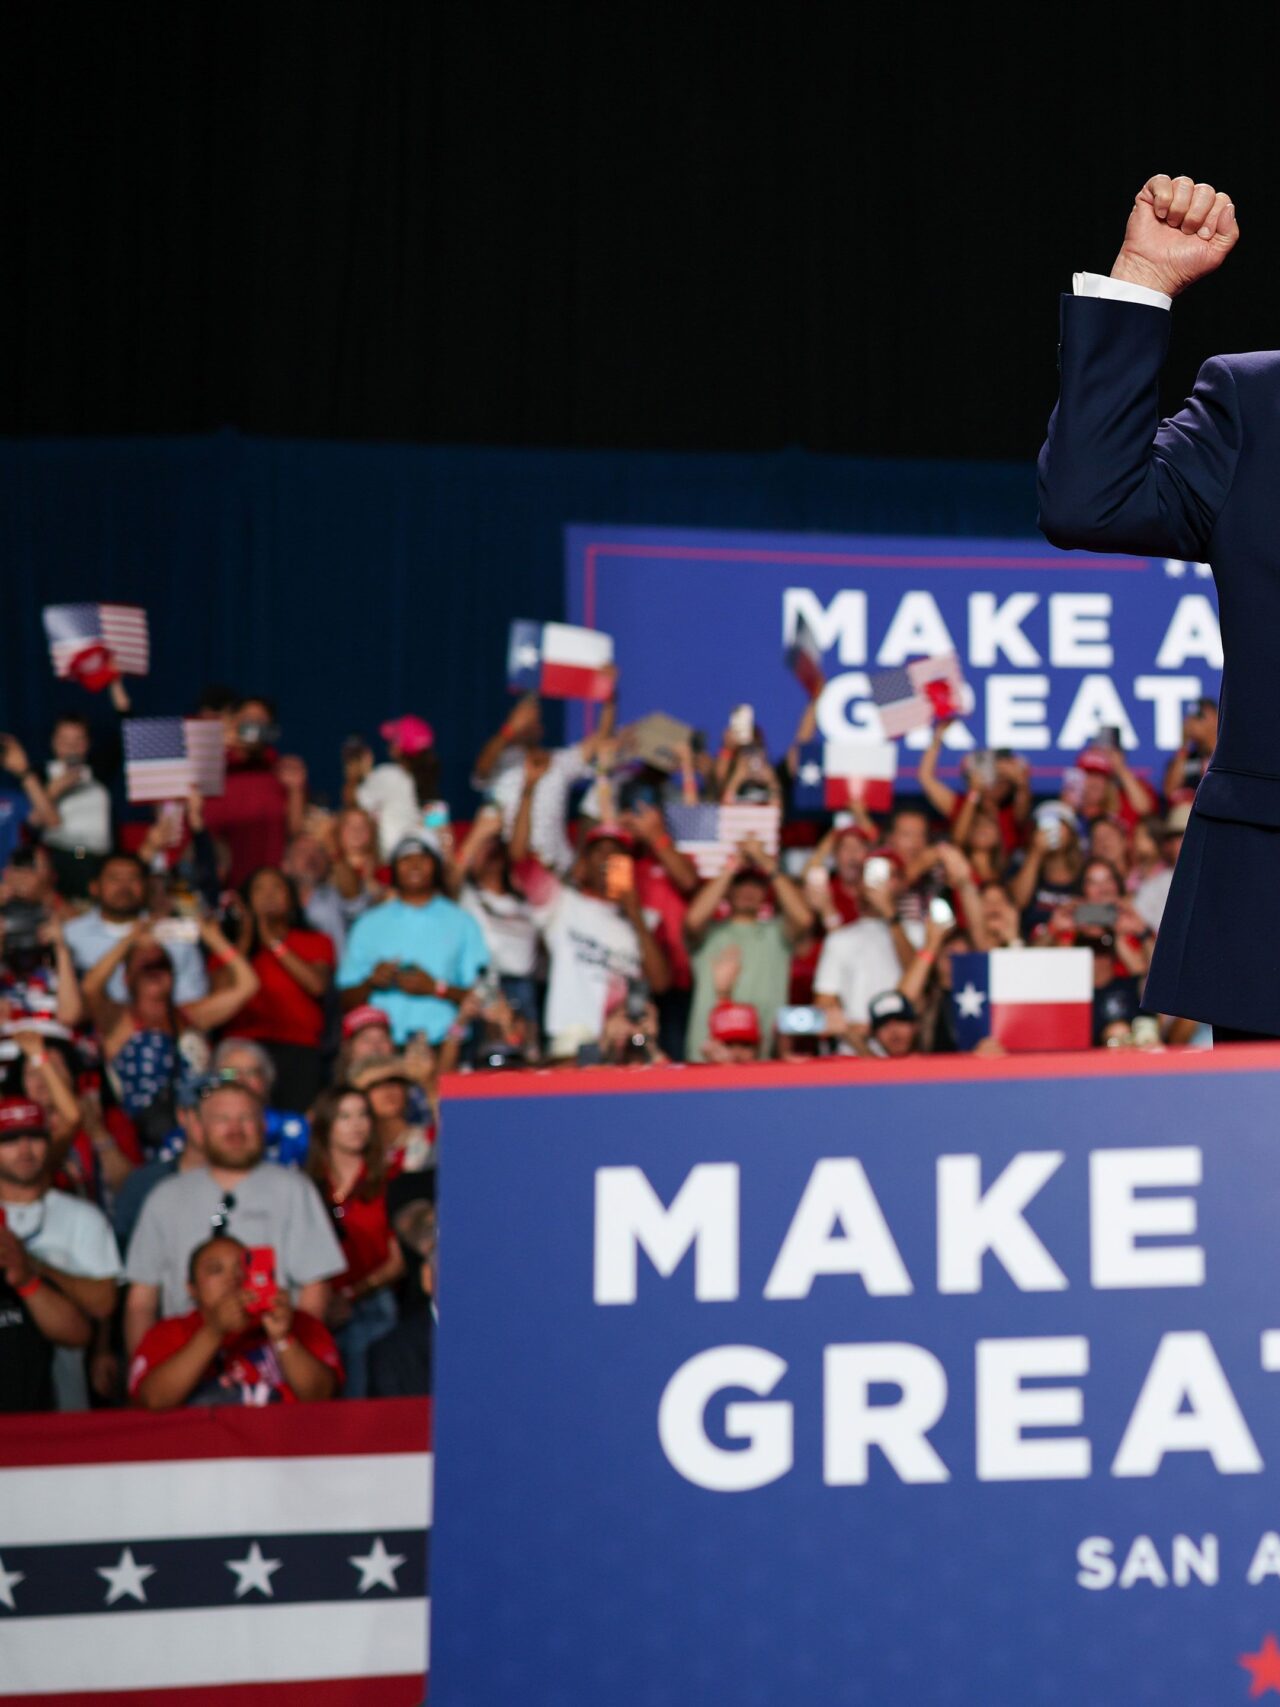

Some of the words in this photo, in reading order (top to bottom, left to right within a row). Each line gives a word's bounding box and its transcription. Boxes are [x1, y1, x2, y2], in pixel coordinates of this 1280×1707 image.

[782, 587, 1113, 668] MAKE
[592, 1144, 1207, 1306] MAKE
[1076, 1533, 1220, 1591] SAN
